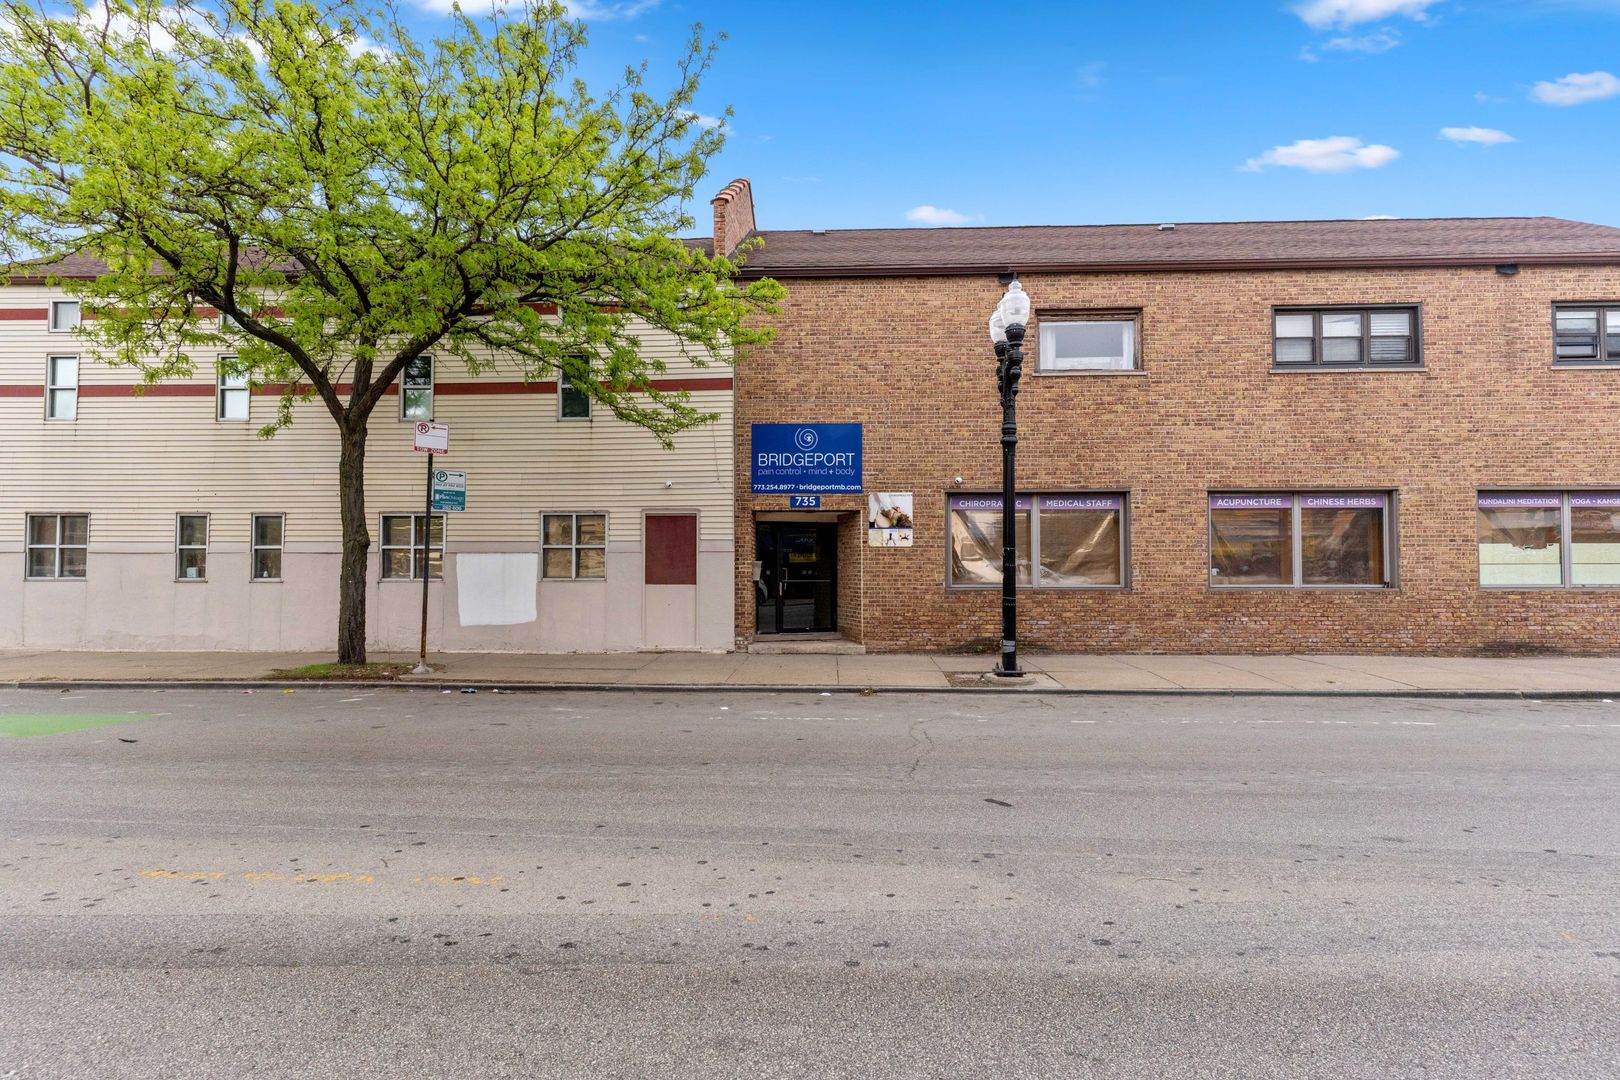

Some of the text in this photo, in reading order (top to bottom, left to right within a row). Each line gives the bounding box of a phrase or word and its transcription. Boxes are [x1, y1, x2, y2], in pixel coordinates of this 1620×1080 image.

[758, 453, 855, 466] BRIDGEPORT
[758, 468, 774, 476] pain
[776, 467, 801, 475] control
[808, 467, 828, 475] mind
[835, 467, 855, 476] body
[795, 496, 816, 506] 735
[959, 500, 1022, 508] CHIROPRAC
[1217, 498, 1282, 506] ACUPUNCTURE
[1307, 498, 1377, 506] CHINESE HERBS
